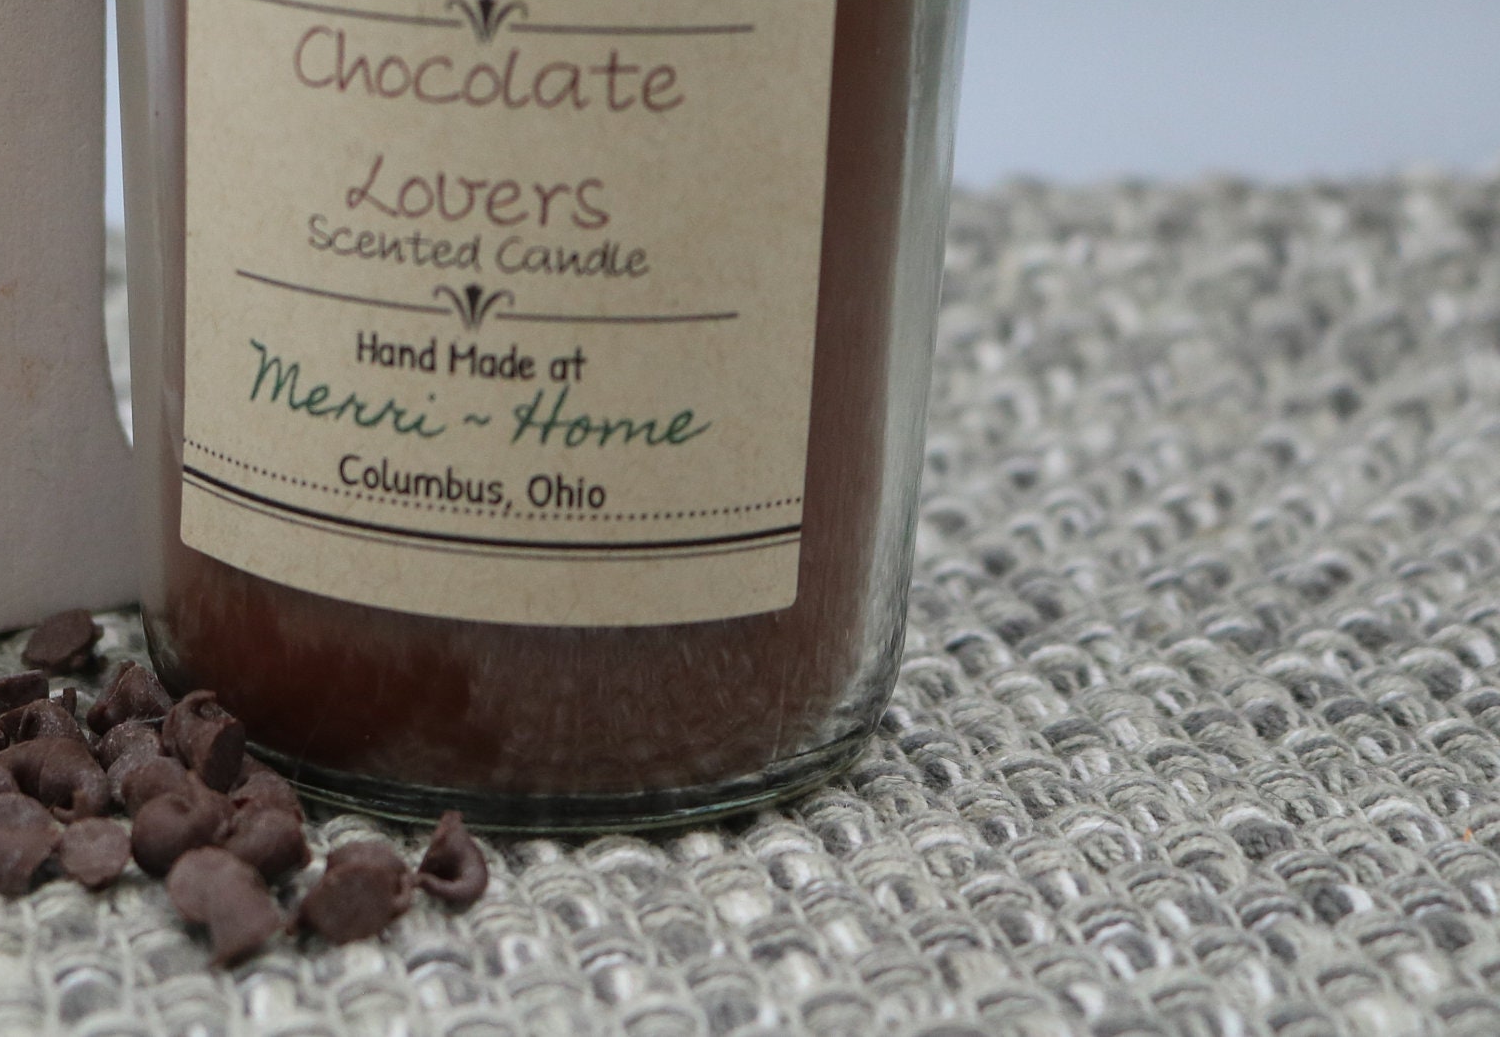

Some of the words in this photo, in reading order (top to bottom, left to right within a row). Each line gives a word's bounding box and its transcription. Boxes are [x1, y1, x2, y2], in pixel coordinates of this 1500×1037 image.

[292, 25, 684, 114] Chocolate
[345, 155, 612, 231] Lovers
[307, 214, 482, 274] Scented
[494, 236, 650, 280] Candle
[357, 332, 437, 375] Hand
[447, 335, 536, 379] Made
[548, 346, 588, 383] at
[248, 340, 446, 439] Merri
[511, 384, 713, 449] Home
[339, 455, 512, 513] Columbus,
[527, 473, 608, 511] Ohio
